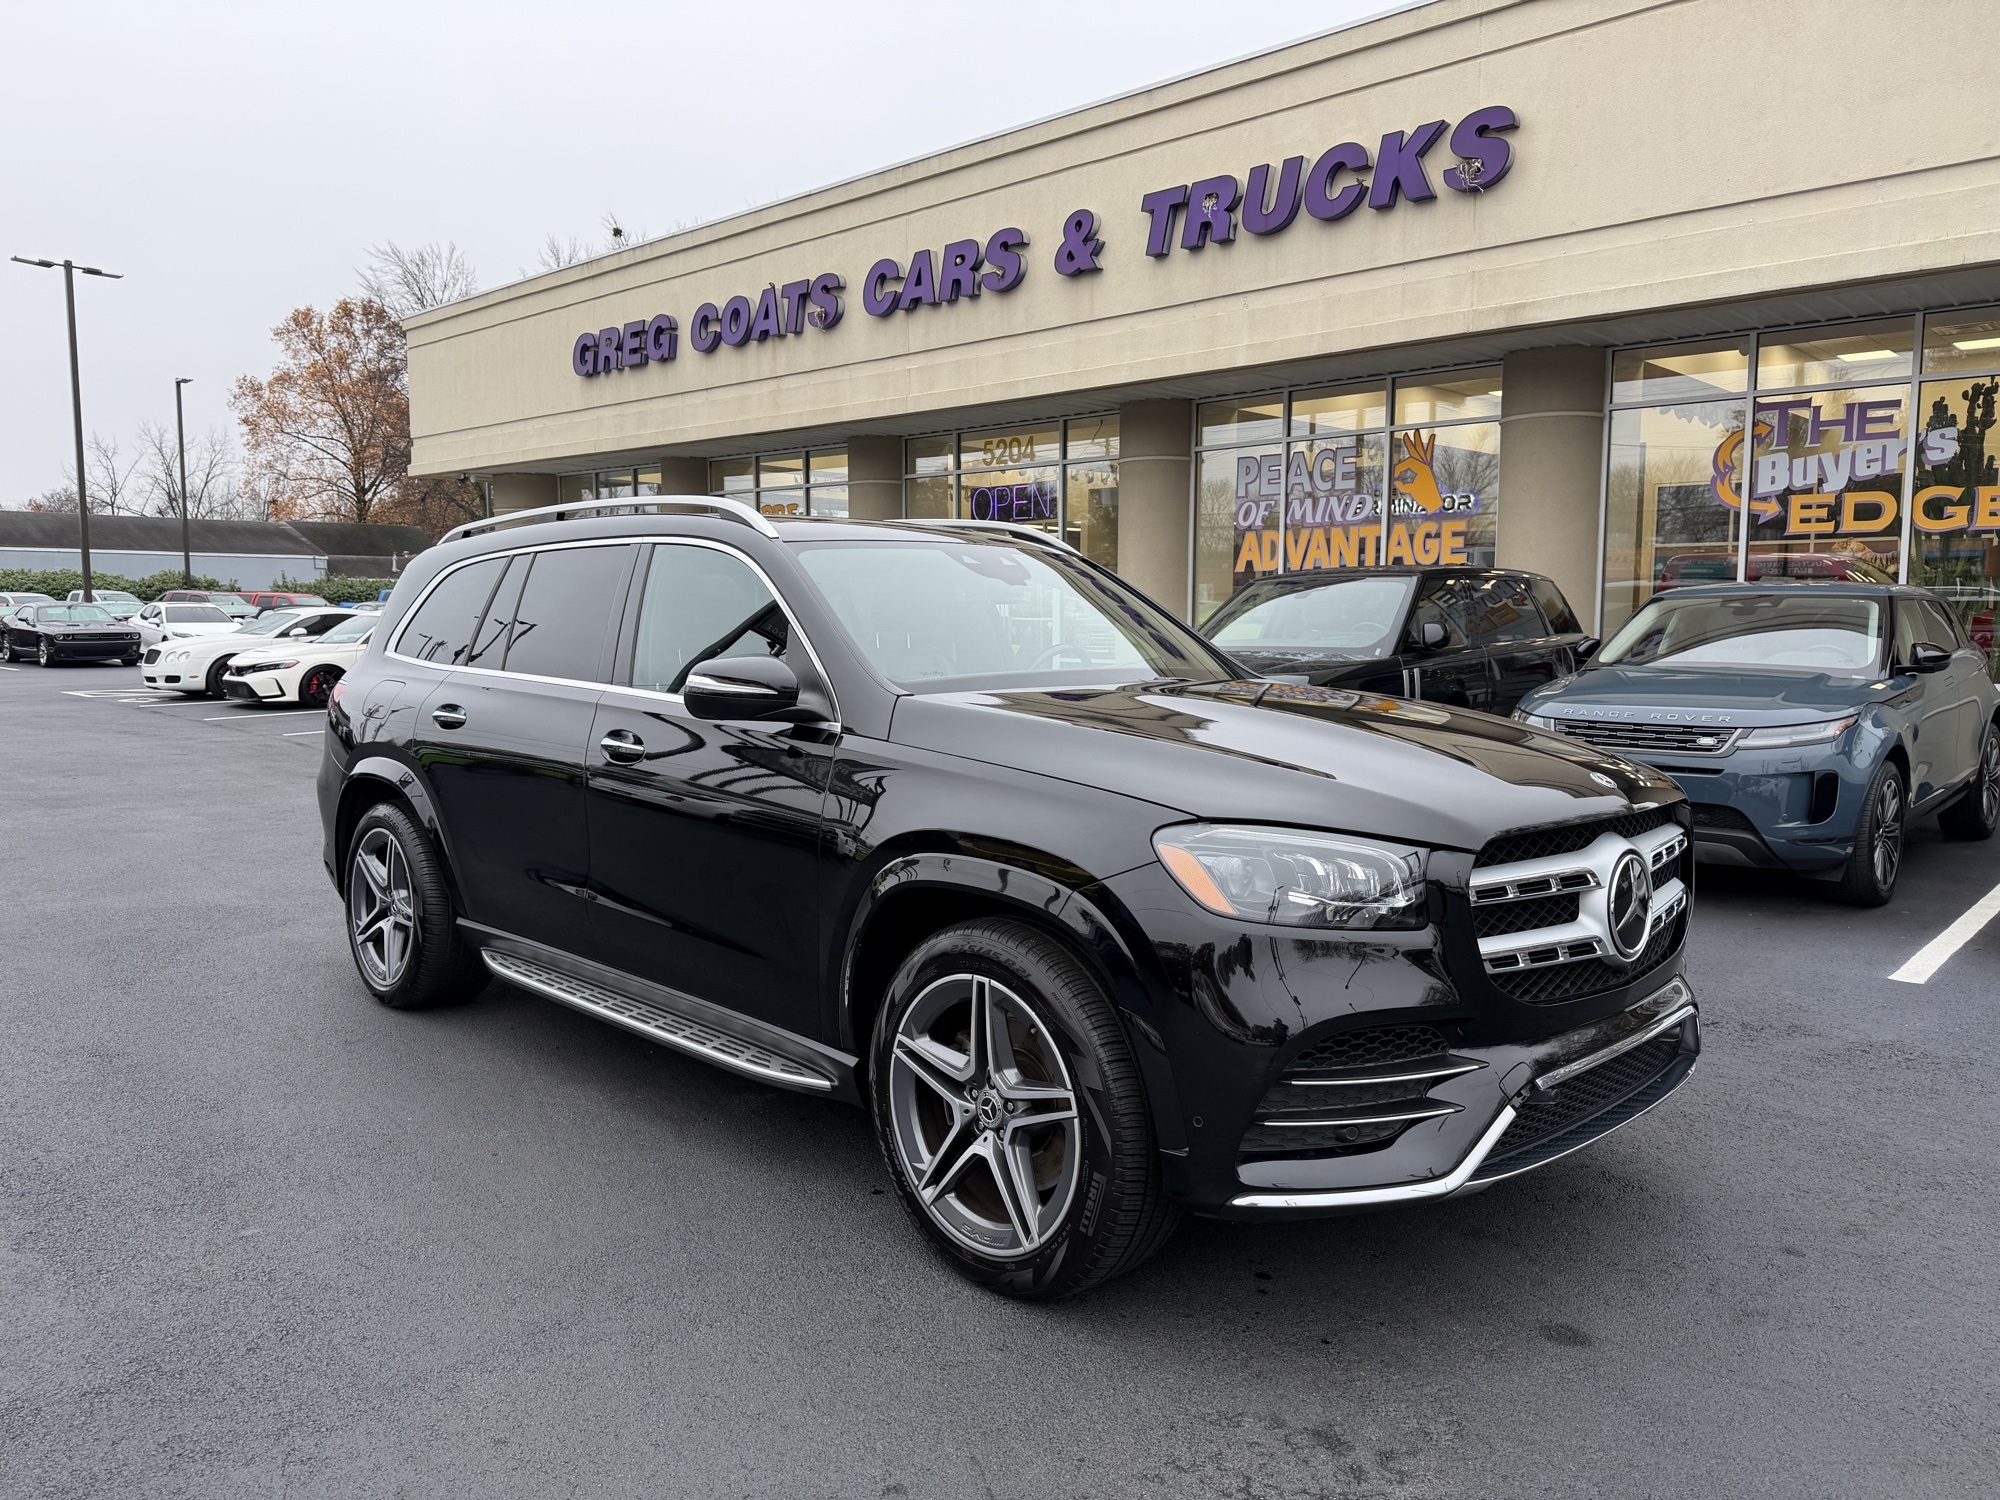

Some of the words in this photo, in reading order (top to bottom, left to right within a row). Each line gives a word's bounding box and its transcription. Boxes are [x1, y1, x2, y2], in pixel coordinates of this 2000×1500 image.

[573, 314, 679, 377] GREG
[691, 272, 847, 354] COATS
[863, 227, 1030, 318] CARS
[1054, 209, 1106, 277] &
[1141, 105, 1520, 259] TRUCKS
[1754, 397, 1902, 449] THE
[982, 435, 1036, 467] 5204
[1237, 446, 1358, 498] PEACE
[1754, 426, 1960, 498] Buyer's
[972, 482, 1051, 521] OPEN
[1235, 500, 1276, 530] OF
[1285, 493, 1376, 528] MIND
[1234, 520, 1469, 573] ADVANTAGE
[1563, 708, 1635, 719] RANGE
[1650, 712, 1732, 723] ROVER
[1079, 1171, 1108, 1236] PIRELLI
